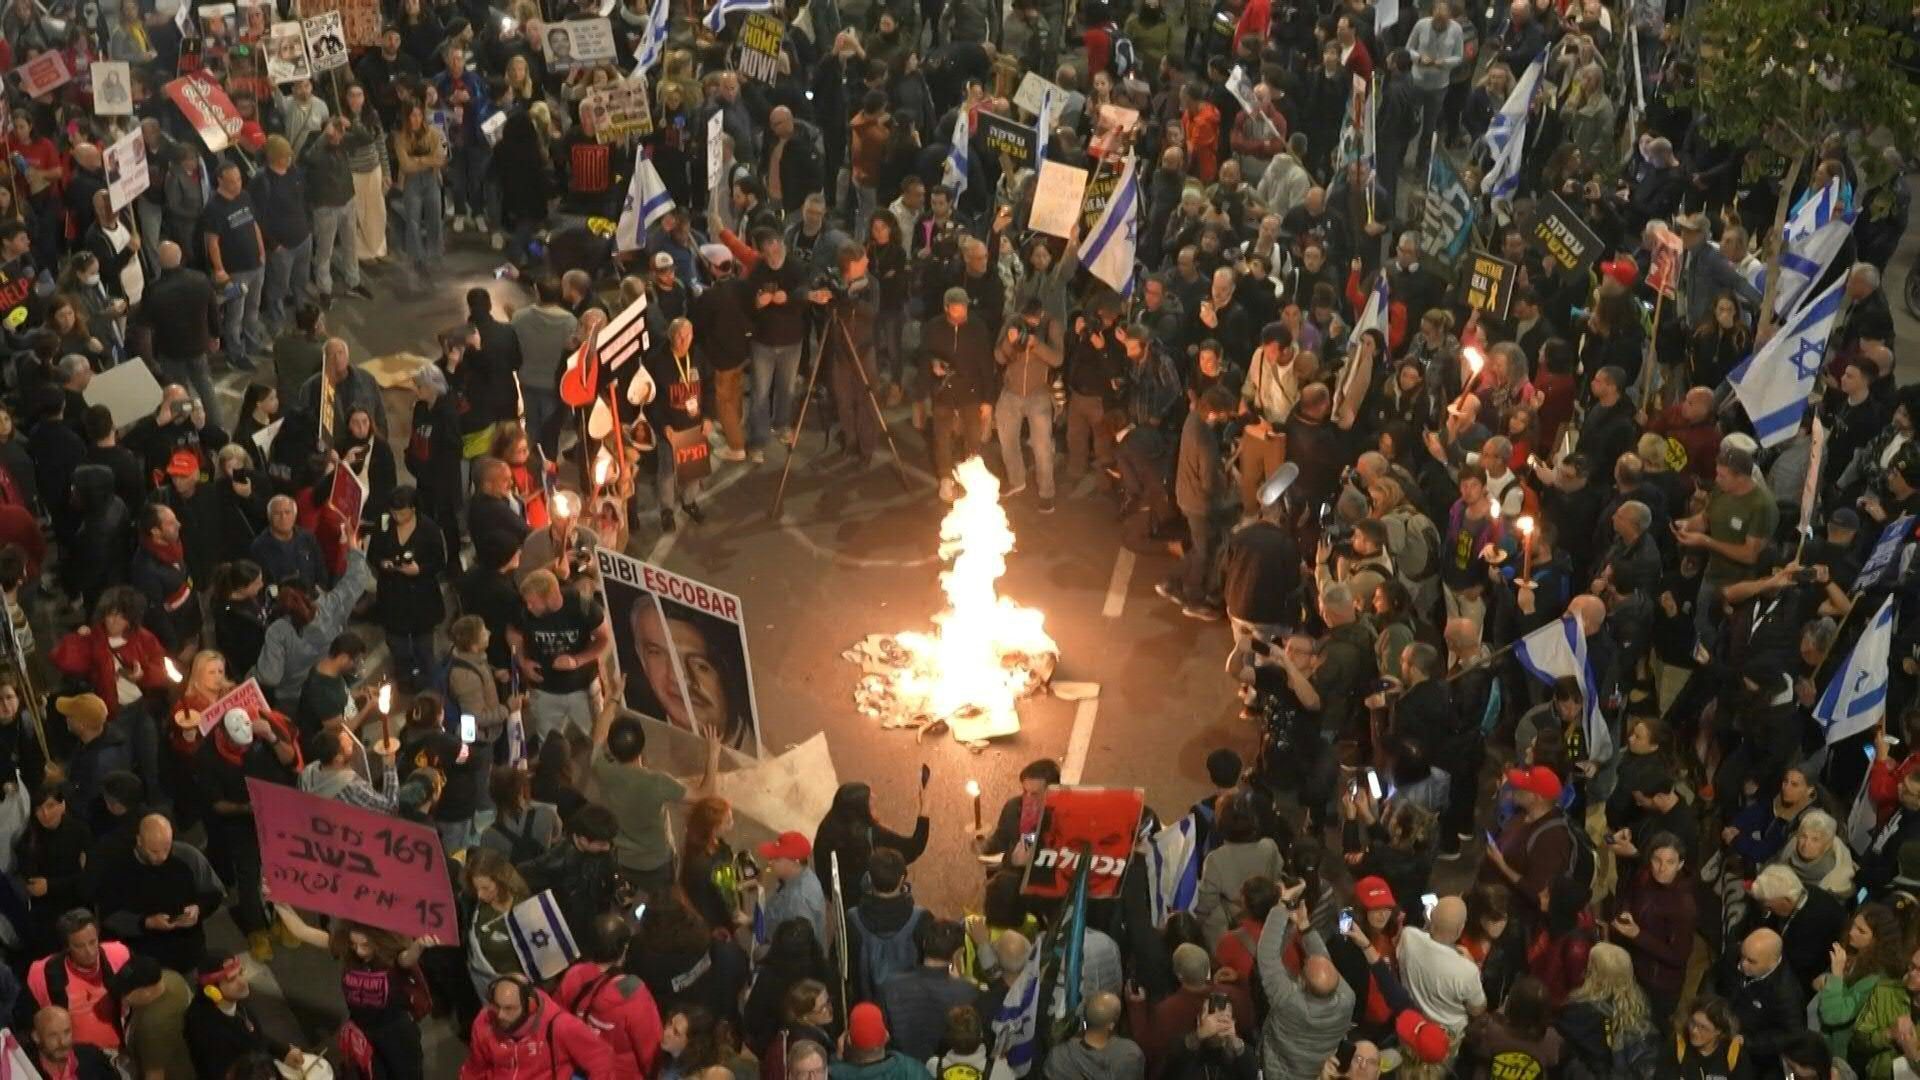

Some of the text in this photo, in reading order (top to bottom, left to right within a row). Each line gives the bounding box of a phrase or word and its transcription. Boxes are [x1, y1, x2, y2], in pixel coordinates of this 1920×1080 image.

[744, 22, 780, 57] HOME
[1546, 215, 1585, 255] עסקה
[598, 551, 737, 620] BIBI ESCOBAR
[374, 829, 433, 873] 169
[415, 899, 447, 928] 15
